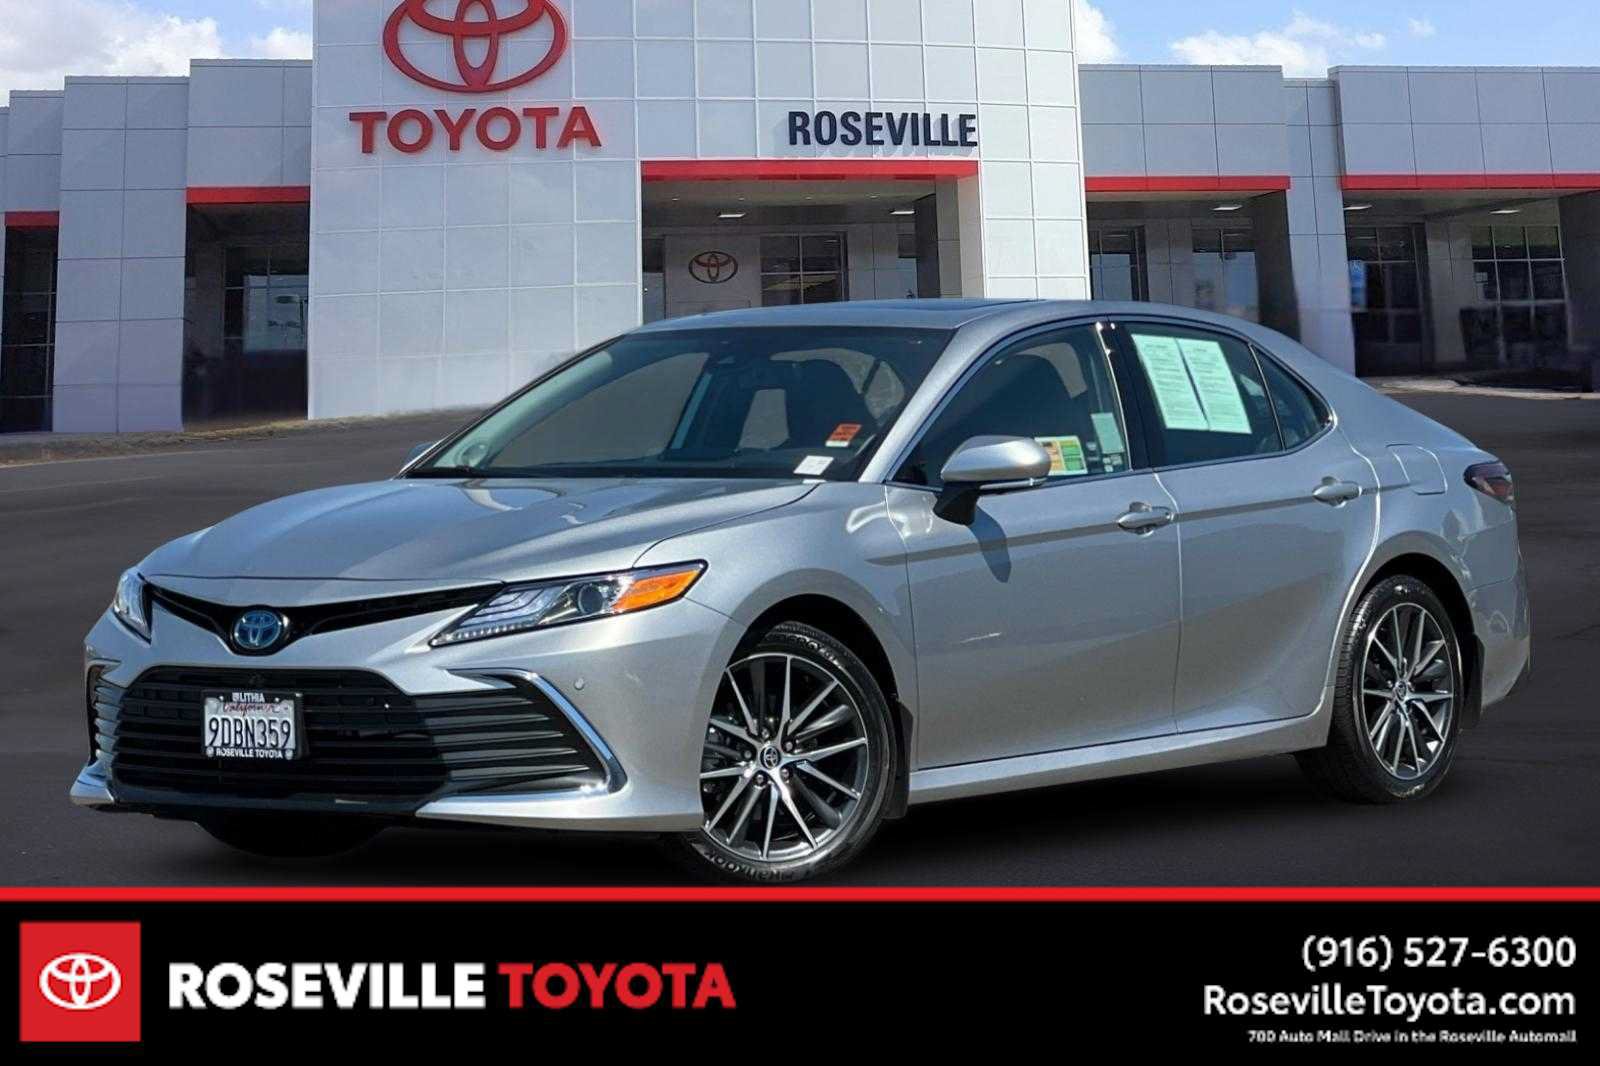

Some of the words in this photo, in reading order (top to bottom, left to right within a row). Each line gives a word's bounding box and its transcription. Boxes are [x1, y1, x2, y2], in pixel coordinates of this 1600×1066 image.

[350, 106, 602, 154] TOYOTA
[788, 111, 978, 147] ROSEVILLE
[209, 717, 291, 749] 9DBN359
[216, 748, 254, 758] ROSEVILLE
[255, 749, 283, 759] TOYOTA
